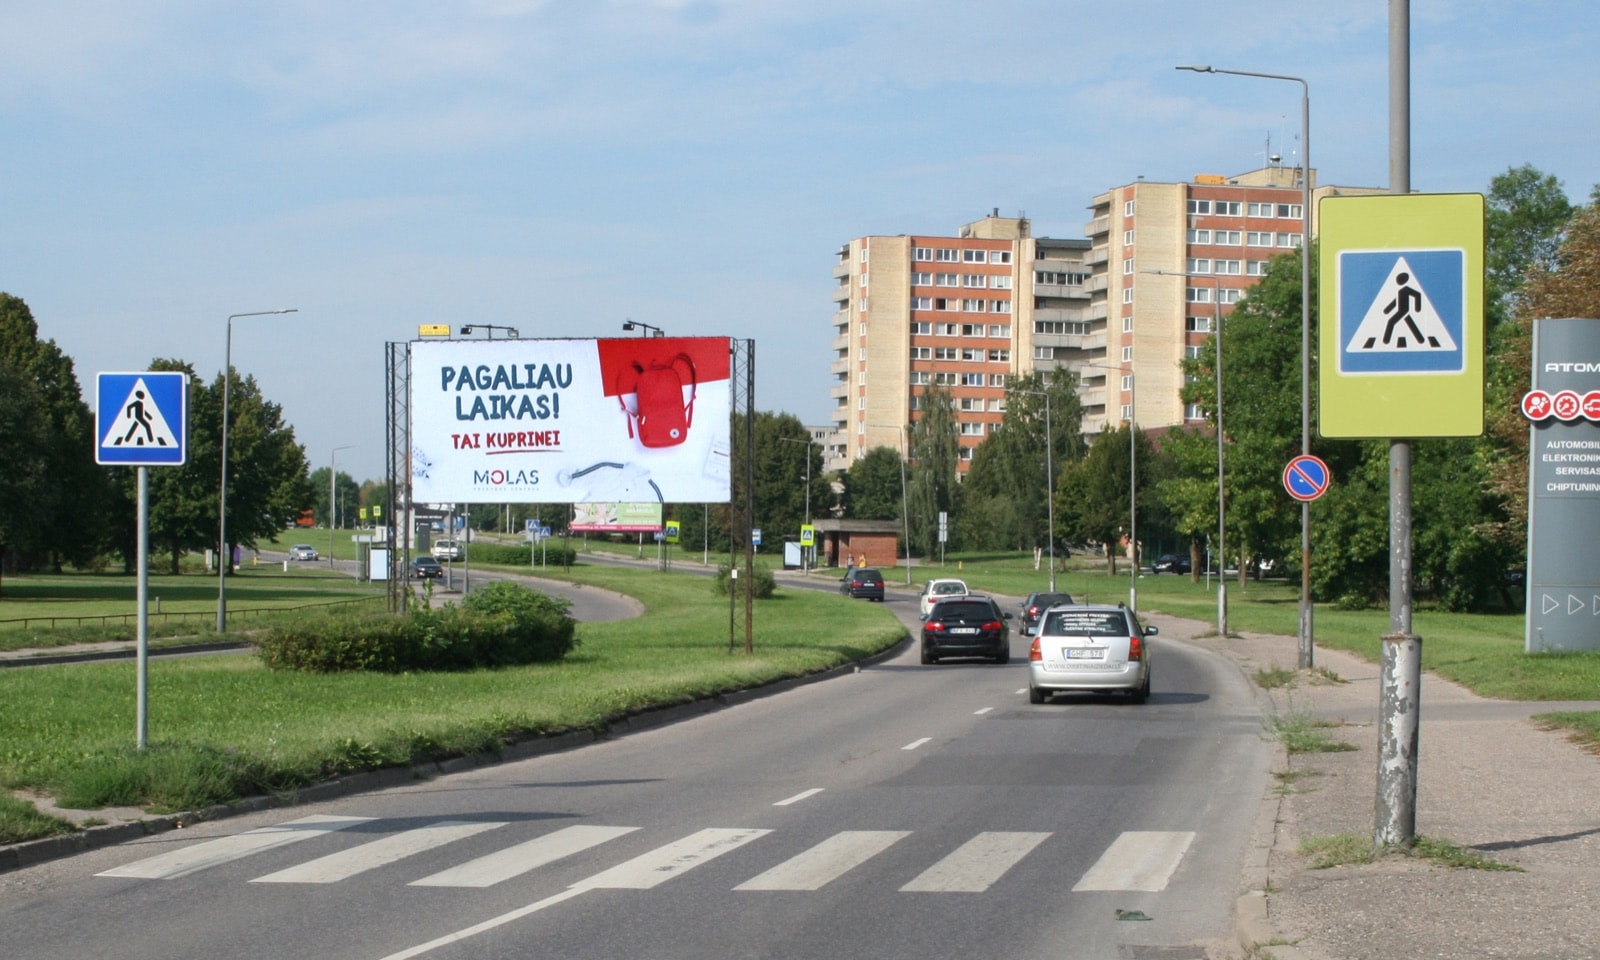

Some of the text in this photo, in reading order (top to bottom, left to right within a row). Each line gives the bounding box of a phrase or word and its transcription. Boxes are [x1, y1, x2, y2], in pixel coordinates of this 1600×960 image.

[441, 363, 573, 392] PAGALIAU
[456, 392, 560, 421] LAIKAS!
[451, 430, 561, 450] TAI KUPRINEI
[474, 469, 539, 485] MOLAS
[1546, 482, 1600, 492] CHIPTUNIN
